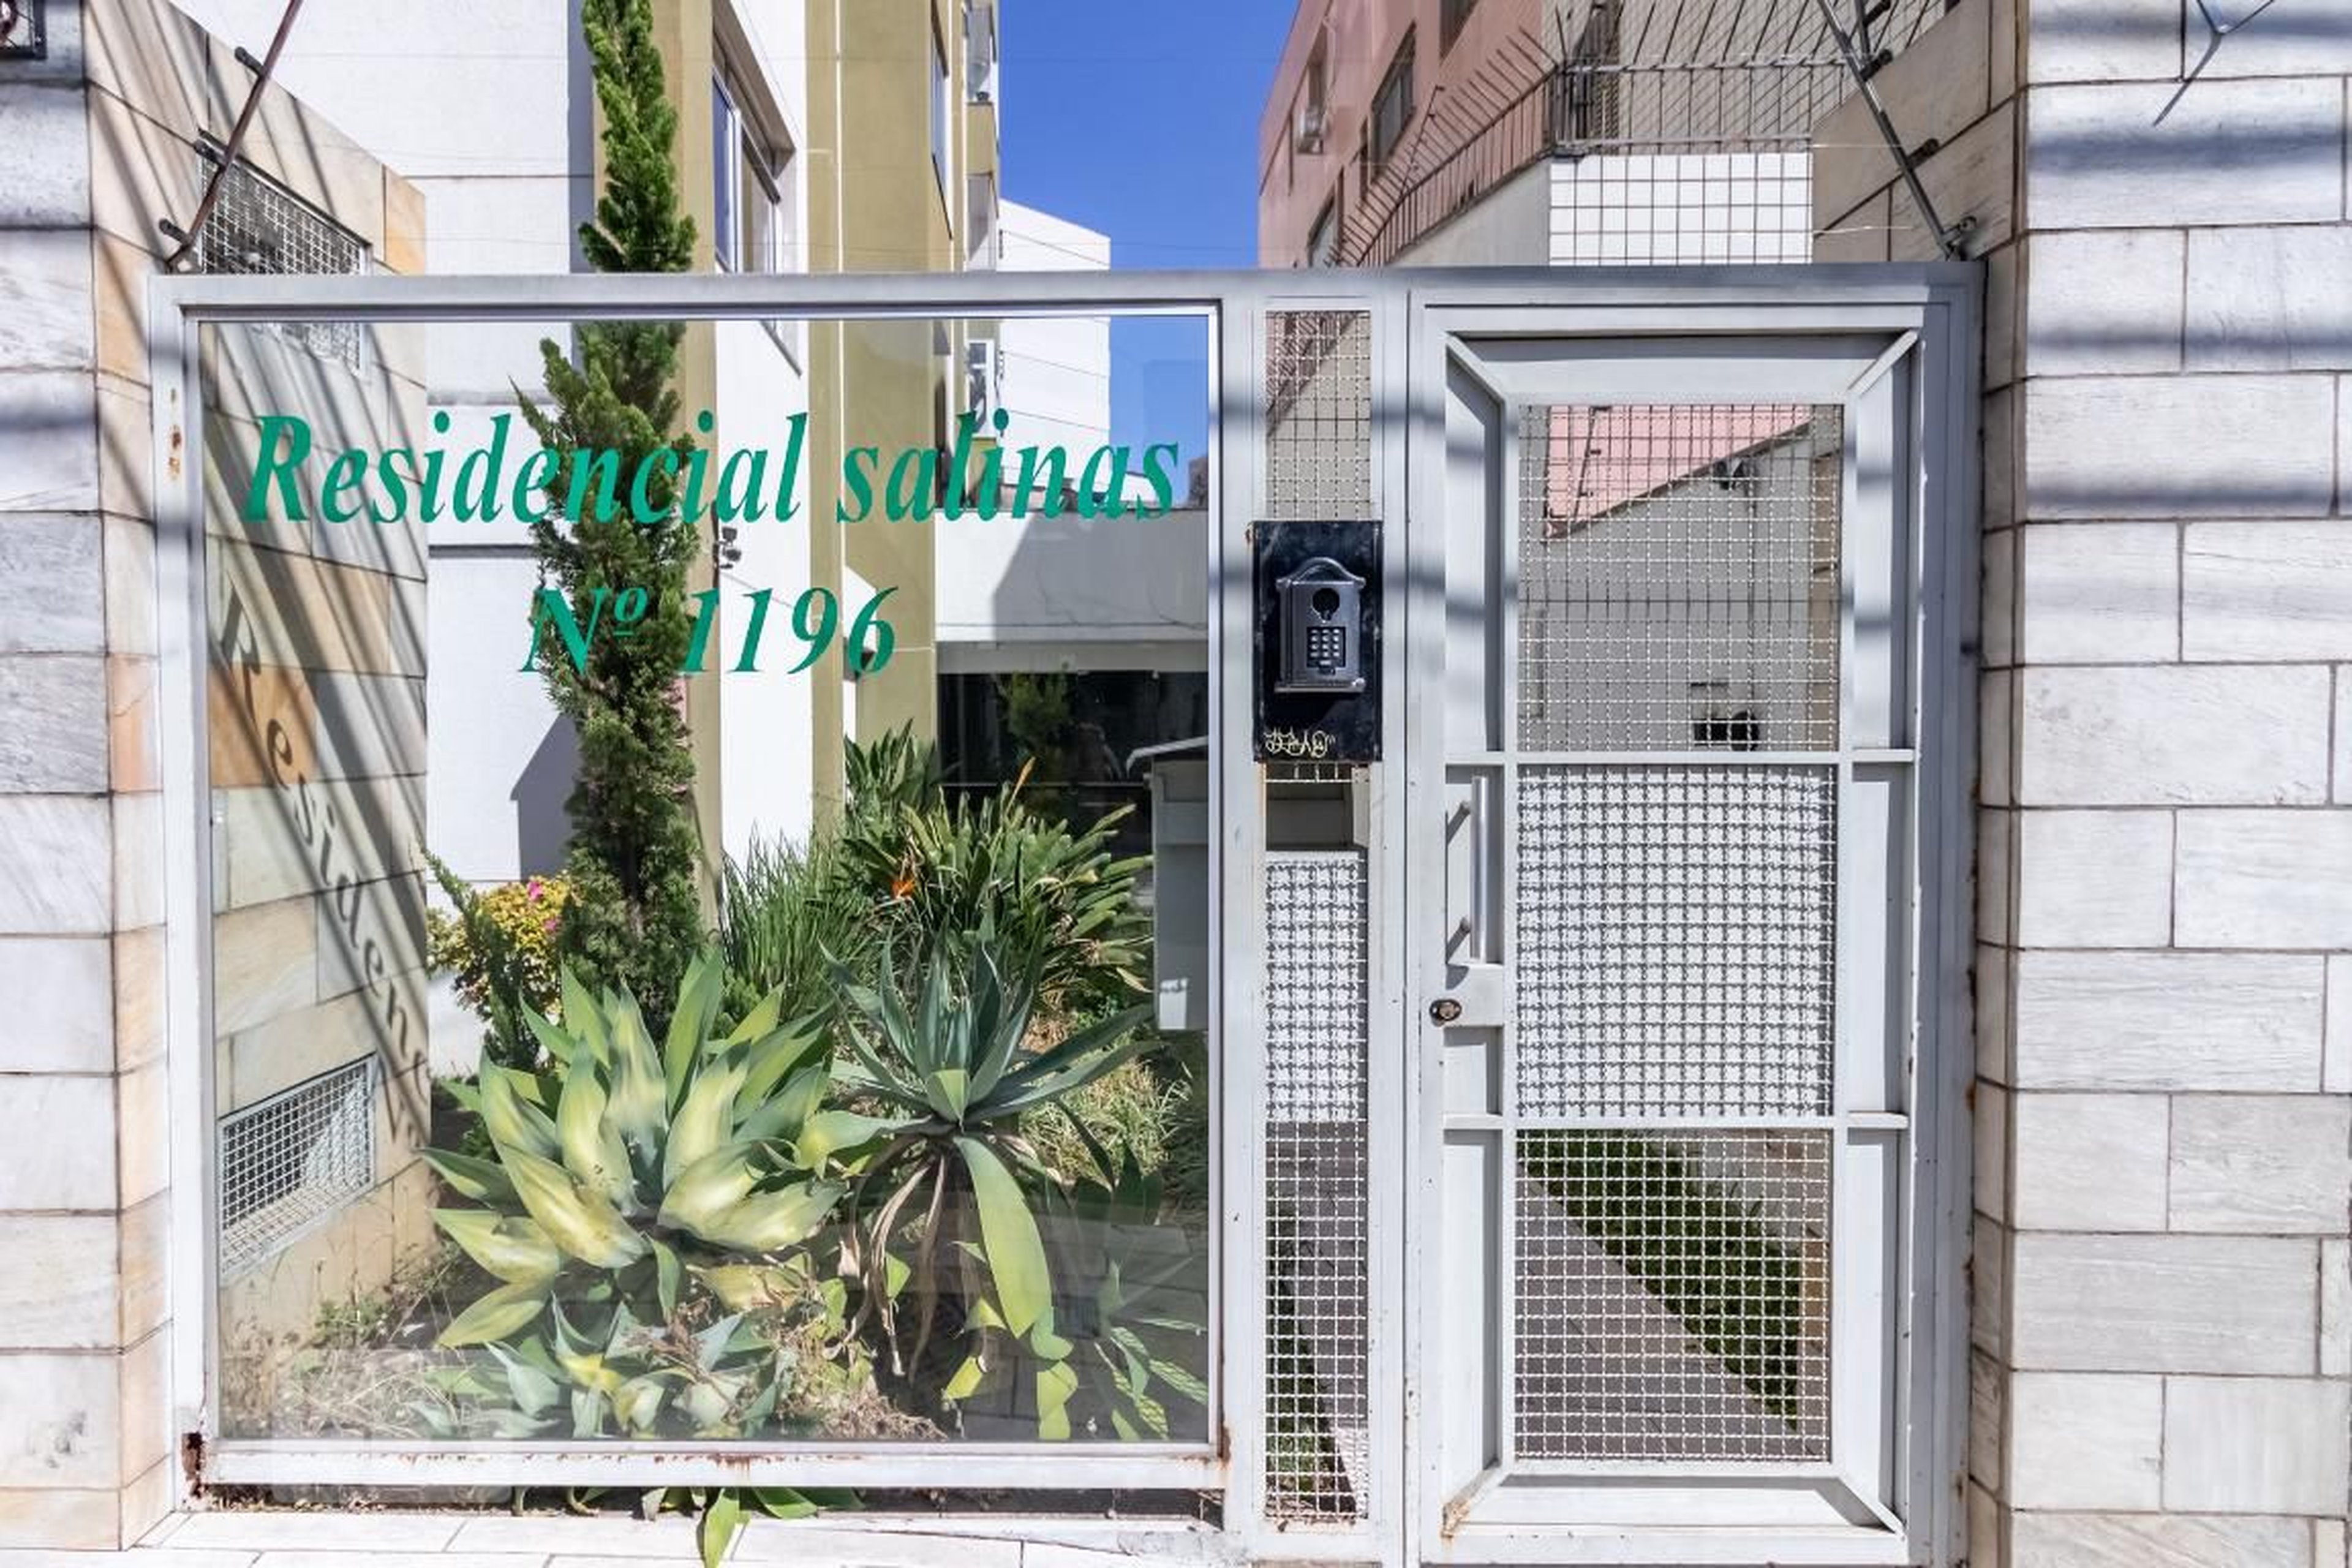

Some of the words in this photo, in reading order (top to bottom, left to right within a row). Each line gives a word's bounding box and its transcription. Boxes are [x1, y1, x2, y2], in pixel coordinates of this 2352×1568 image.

[243, 410, 807, 525] Residencial
[836, 408, 1179, 525] salinas
[522, 586, 649, 675] Nº
[682, 586, 899, 676] 1196
